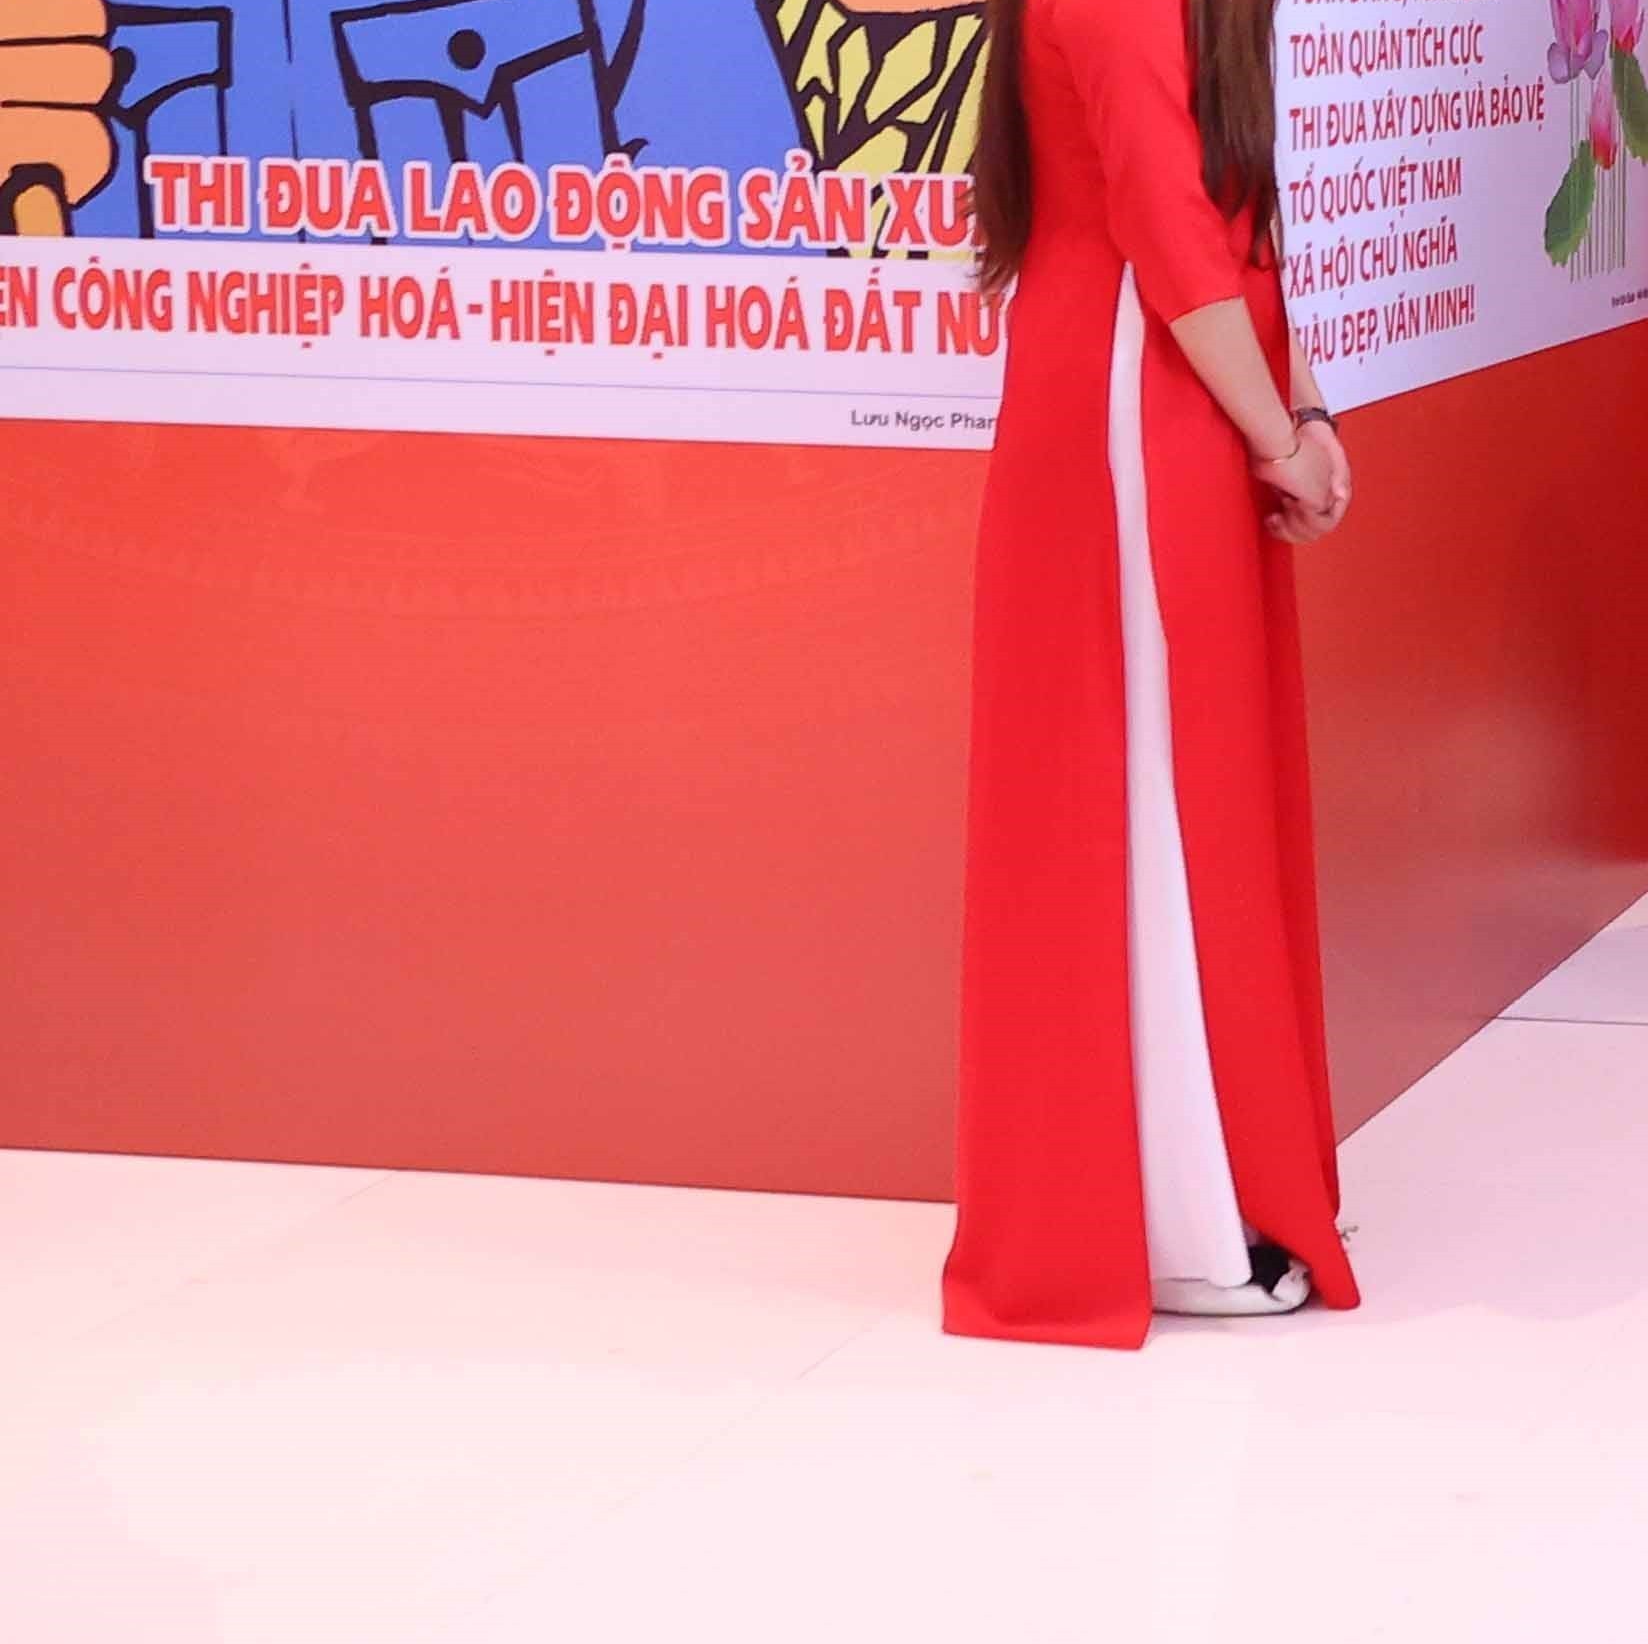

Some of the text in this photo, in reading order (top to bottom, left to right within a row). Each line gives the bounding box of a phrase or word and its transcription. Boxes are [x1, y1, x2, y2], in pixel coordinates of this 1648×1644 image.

[1290, 18, 1484, 78] TOÀN QUÂN TÍCH CỰC
[1290, 73, 1544, 151] THI ĐUA XÂY DỰNG VÀ BẢO VỆ
[151, 156, 987, 250] THI ĐUA LAO ĐỘNG SẢN XU
[1289, 156, 1461, 225] TỔ QUỐC VIỆT NAM
[1288, 216, 1457, 300] XÃ HỘI CHỦ NGHĨA
[53, 256, 173, 332] CÔNG
[187, 263, 344, 349] NGHIỆP
[608, 282, 688, 359] ĐẠI
[705, 277, 810, 351] HOÁ
[824, 266, 921, 354] ĐẤT
[1296, 284, 1475, 366] IÀU ĐẸP, VĂN MINH!
[851, 409, 889, 426] Lưu
[895, 411, 945, 432] Ngọc
